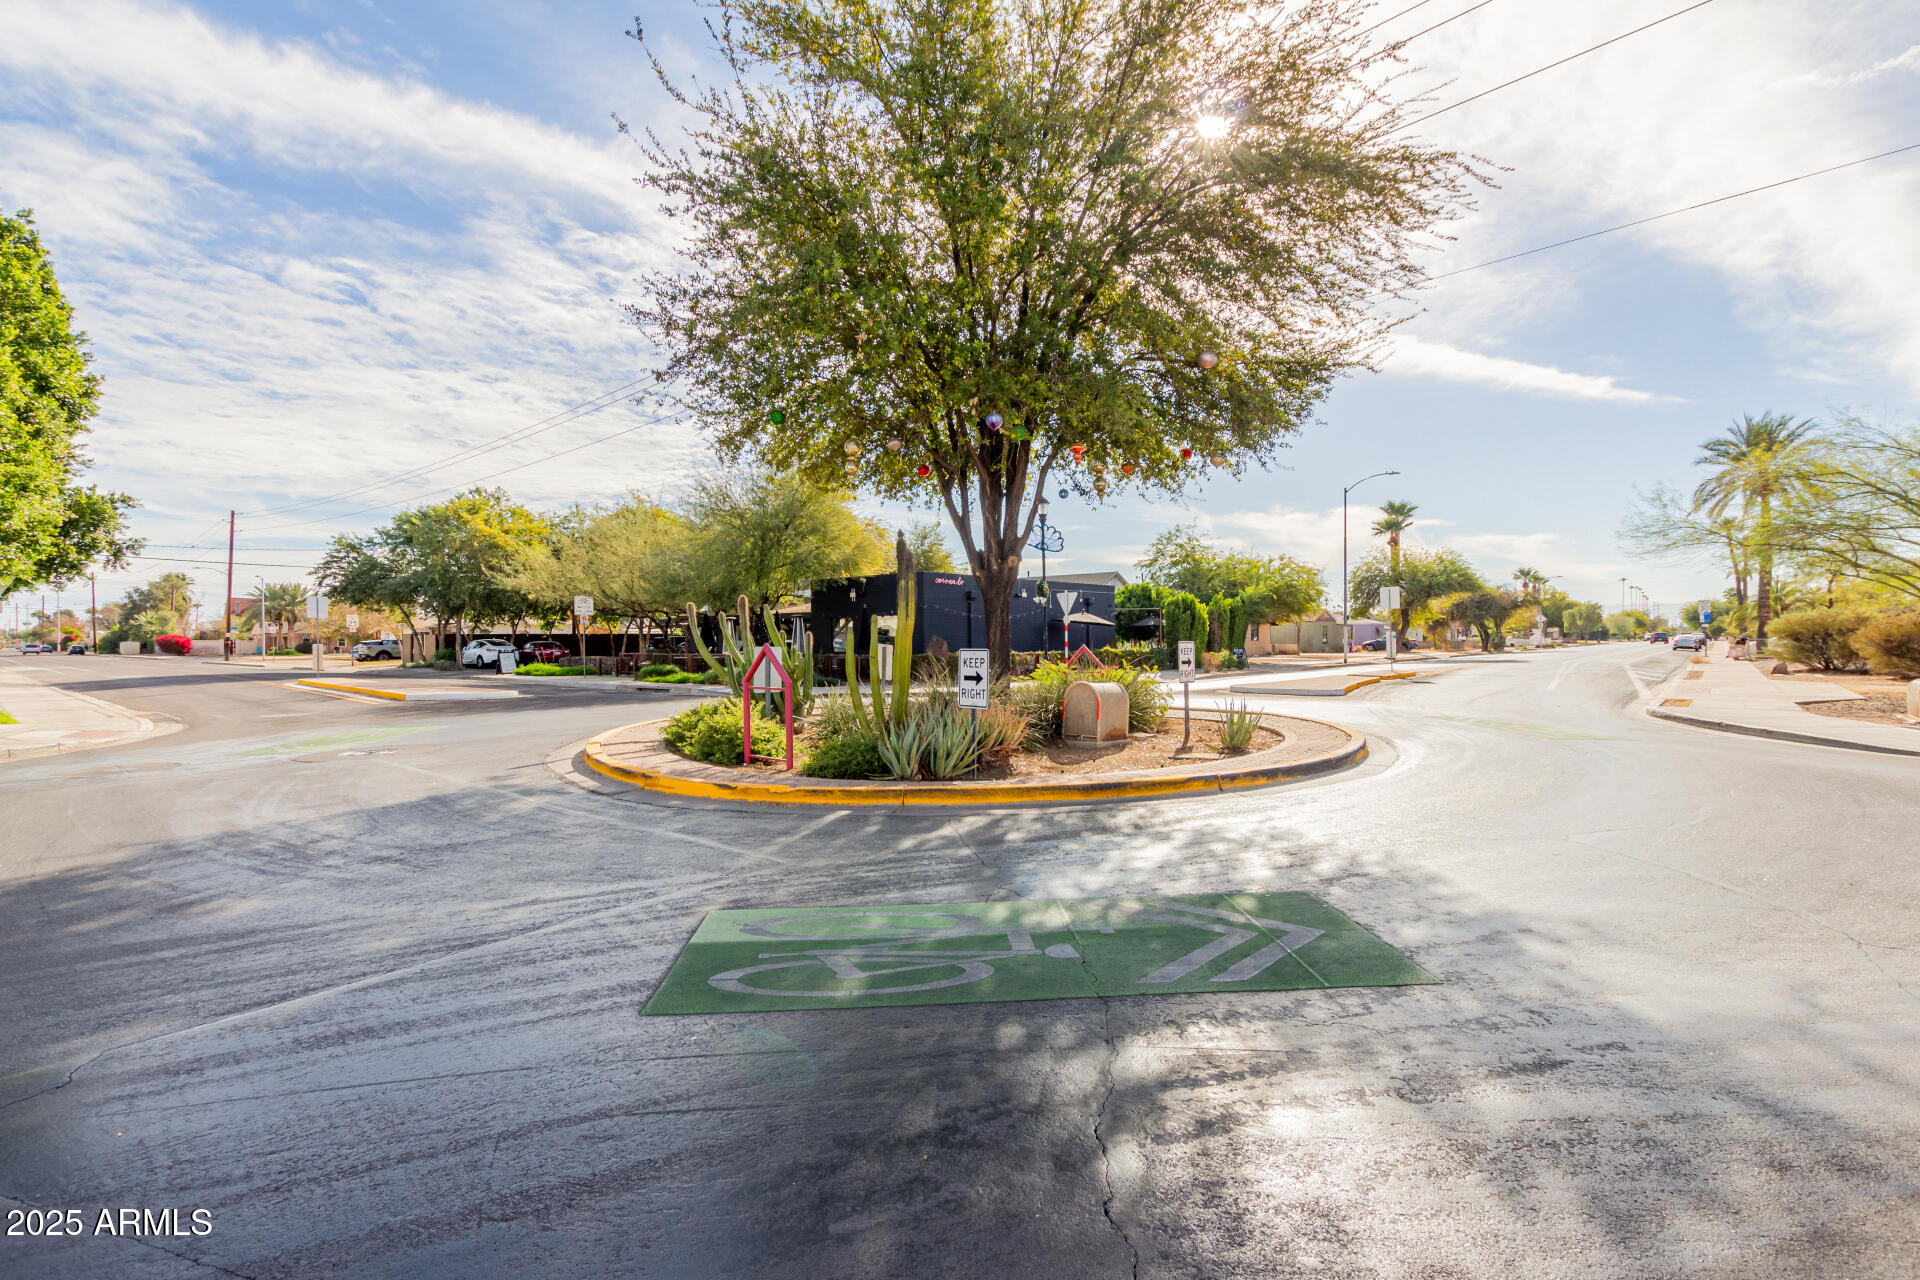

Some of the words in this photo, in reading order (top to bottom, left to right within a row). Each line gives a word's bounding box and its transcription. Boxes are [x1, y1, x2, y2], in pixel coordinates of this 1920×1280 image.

[1181, 647, 1192, 656] KEEP
[963, 657, 985, 668] KEEP
[1180, 669, 1193, 678] RIGHT
[962, 688, 985, 700] RIGHT
